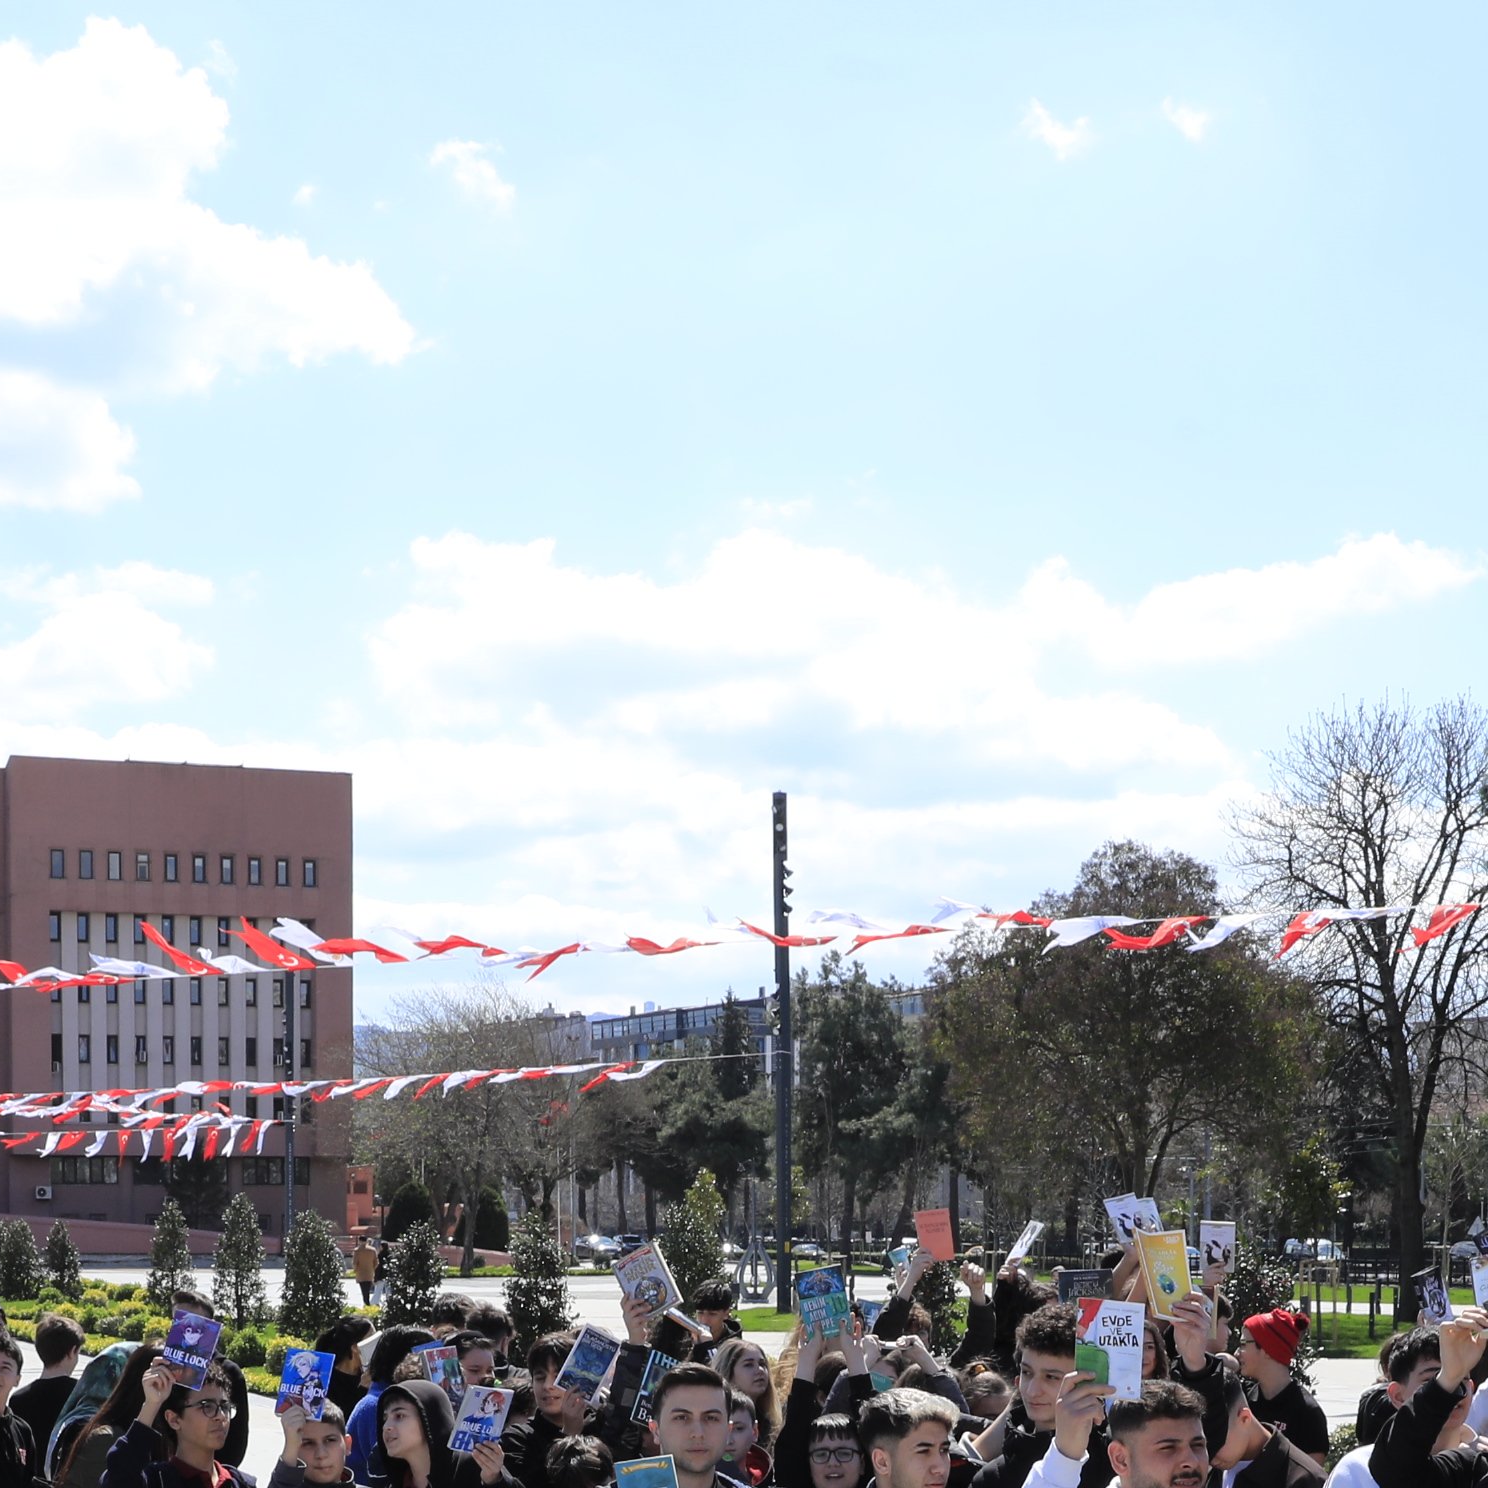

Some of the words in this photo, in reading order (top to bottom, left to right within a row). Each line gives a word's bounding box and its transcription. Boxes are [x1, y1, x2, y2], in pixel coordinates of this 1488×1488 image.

[1068, 1286, 1106, 1298] JACKSON
[806, 1318, 836, 1334] MPPE
[1101, 1315, 1133, 1327] EVDE
[1110, 1327, 1123, 1336] VE
[1098, 1333, 1140, 1348] UZAKTA
[163, 1346, 185, 1361] BLUE
[184, 1353, 209, 1369] LOCK
[280, 1383, 302, 1395] BLUE
